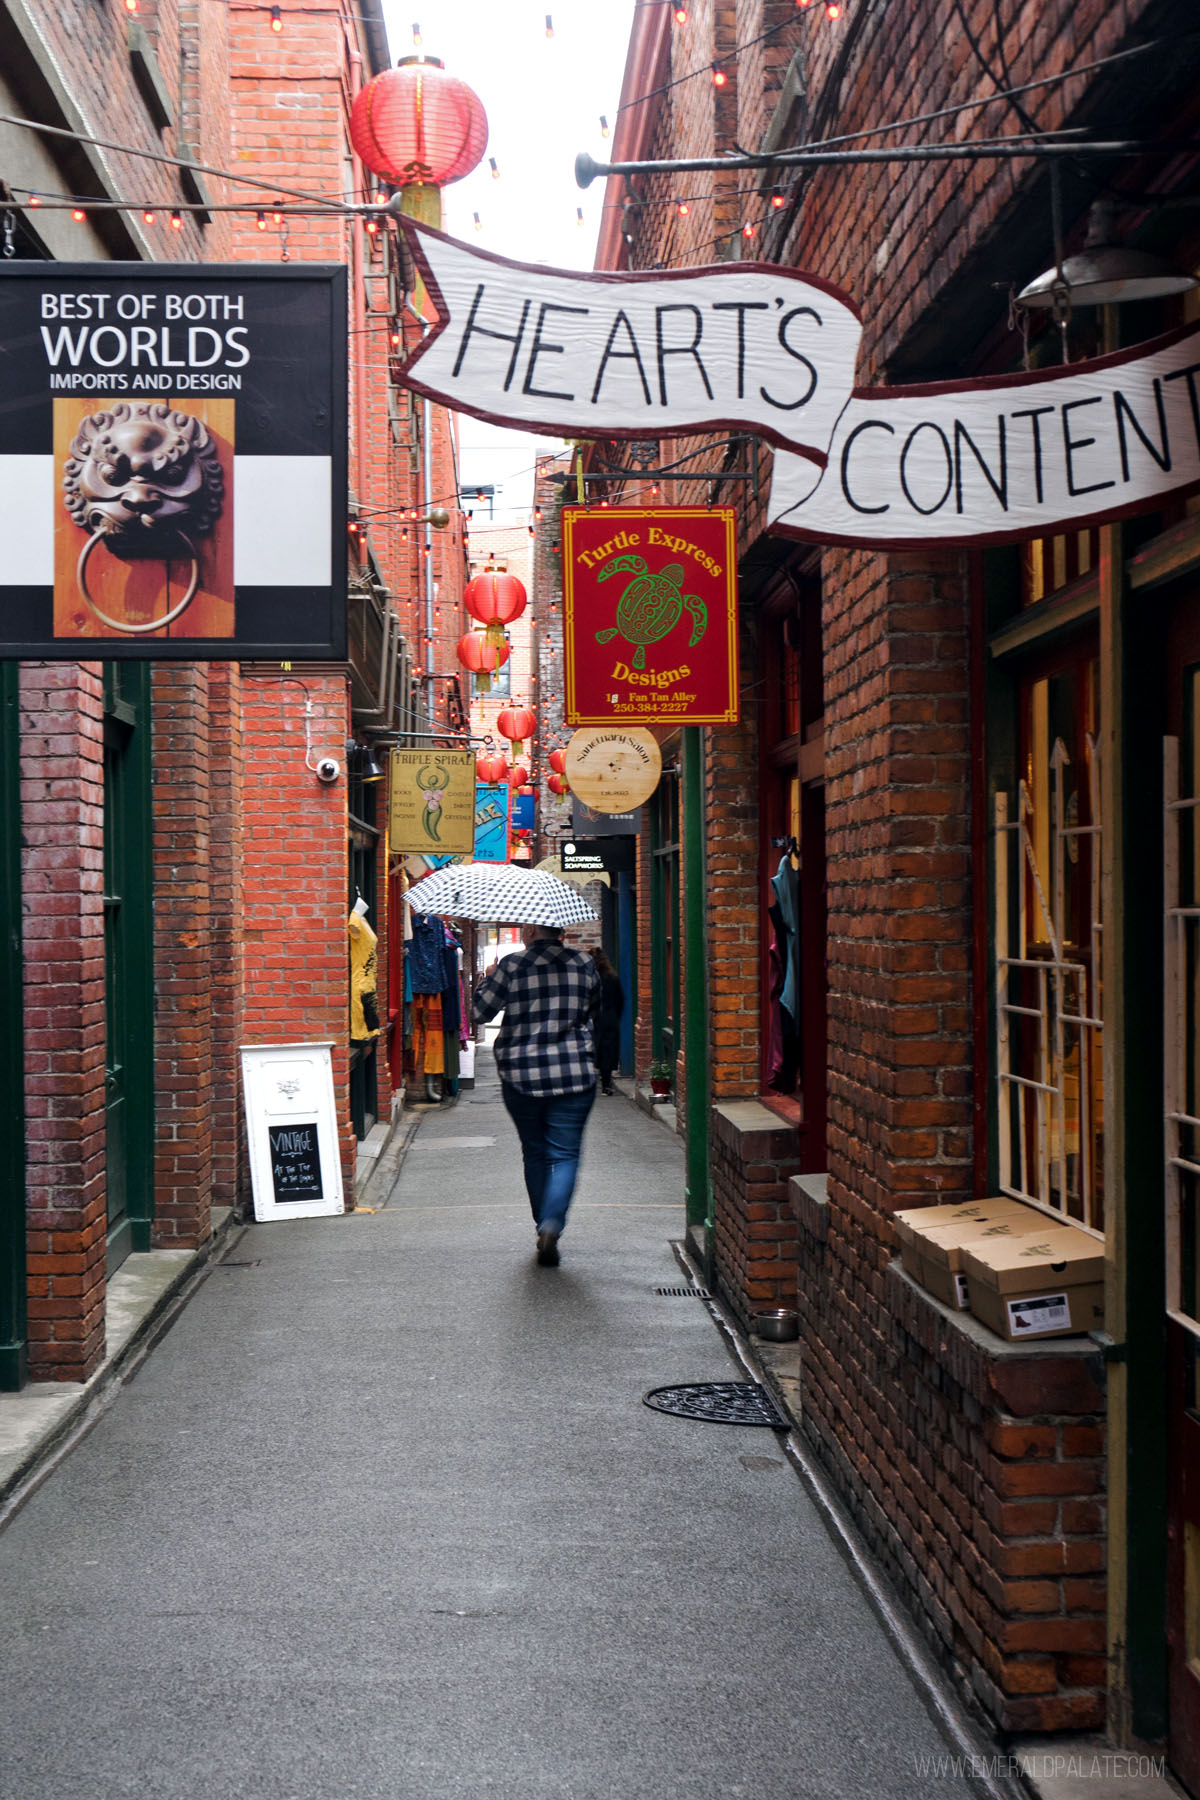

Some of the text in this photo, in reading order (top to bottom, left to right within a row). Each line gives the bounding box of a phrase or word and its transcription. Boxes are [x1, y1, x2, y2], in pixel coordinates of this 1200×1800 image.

[41, 294, 244, 320] BEST OF BOTH
[40, 326, 251, 367] WORLDS
[452, 283, 824, 411] HEART'S
[50, 373, 242, 390] IMPORTS AND DESIGN
[577, 527, 723, 577] Turtle Express
[610, 662, 691, 689] Designs
[613, 703, 688, 712] 250-384-2227
[629, 692, 648, 702] Fan
[649, 692, 669, 702] Tan
[671, 692, 696, 703] Alley
[395, 754, 472, 765] TRIPLE SPIRAL
[577, 734, 650, 763] Sanctuary Salon
[270, 1131, 313, 1151] VINTAGE
